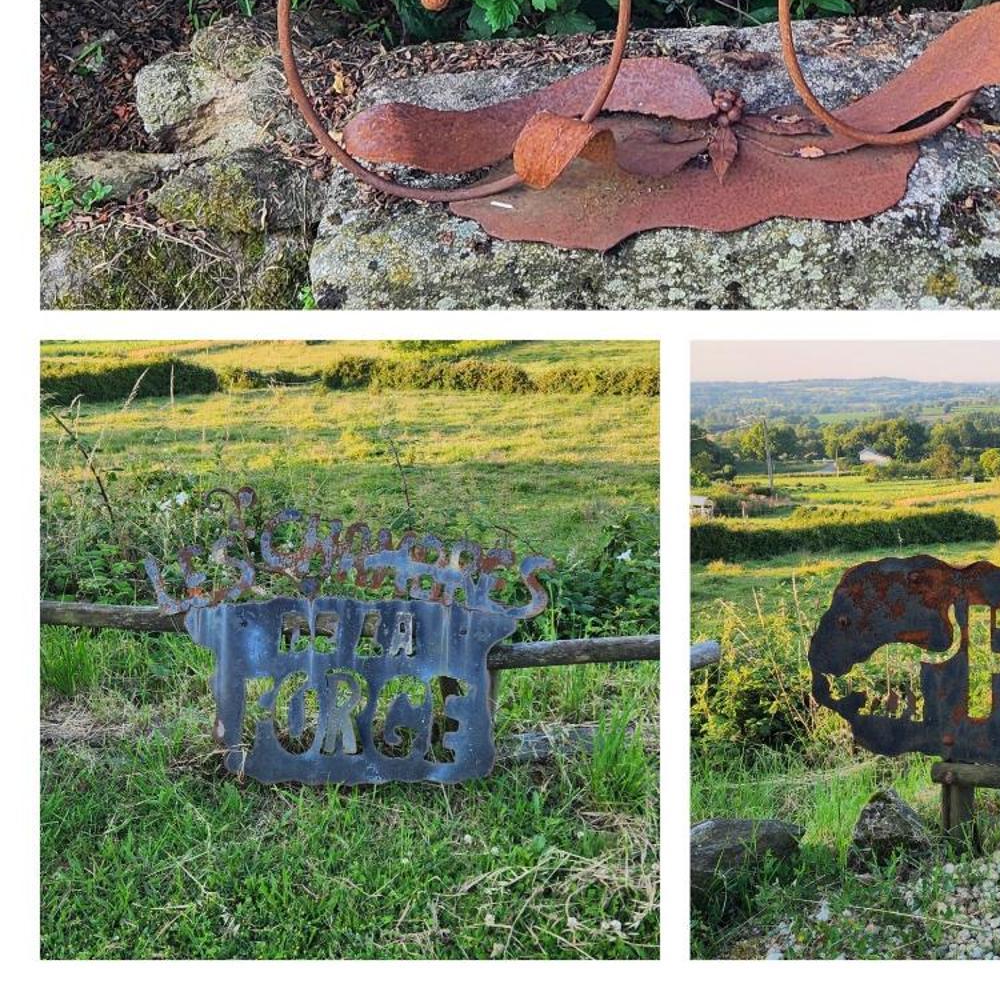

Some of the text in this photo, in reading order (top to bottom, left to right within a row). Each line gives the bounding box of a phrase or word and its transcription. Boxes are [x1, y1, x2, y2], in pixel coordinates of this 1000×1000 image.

[278, 609, 418, 658] DE LA
[243, 670, 475, 765] FORGE
